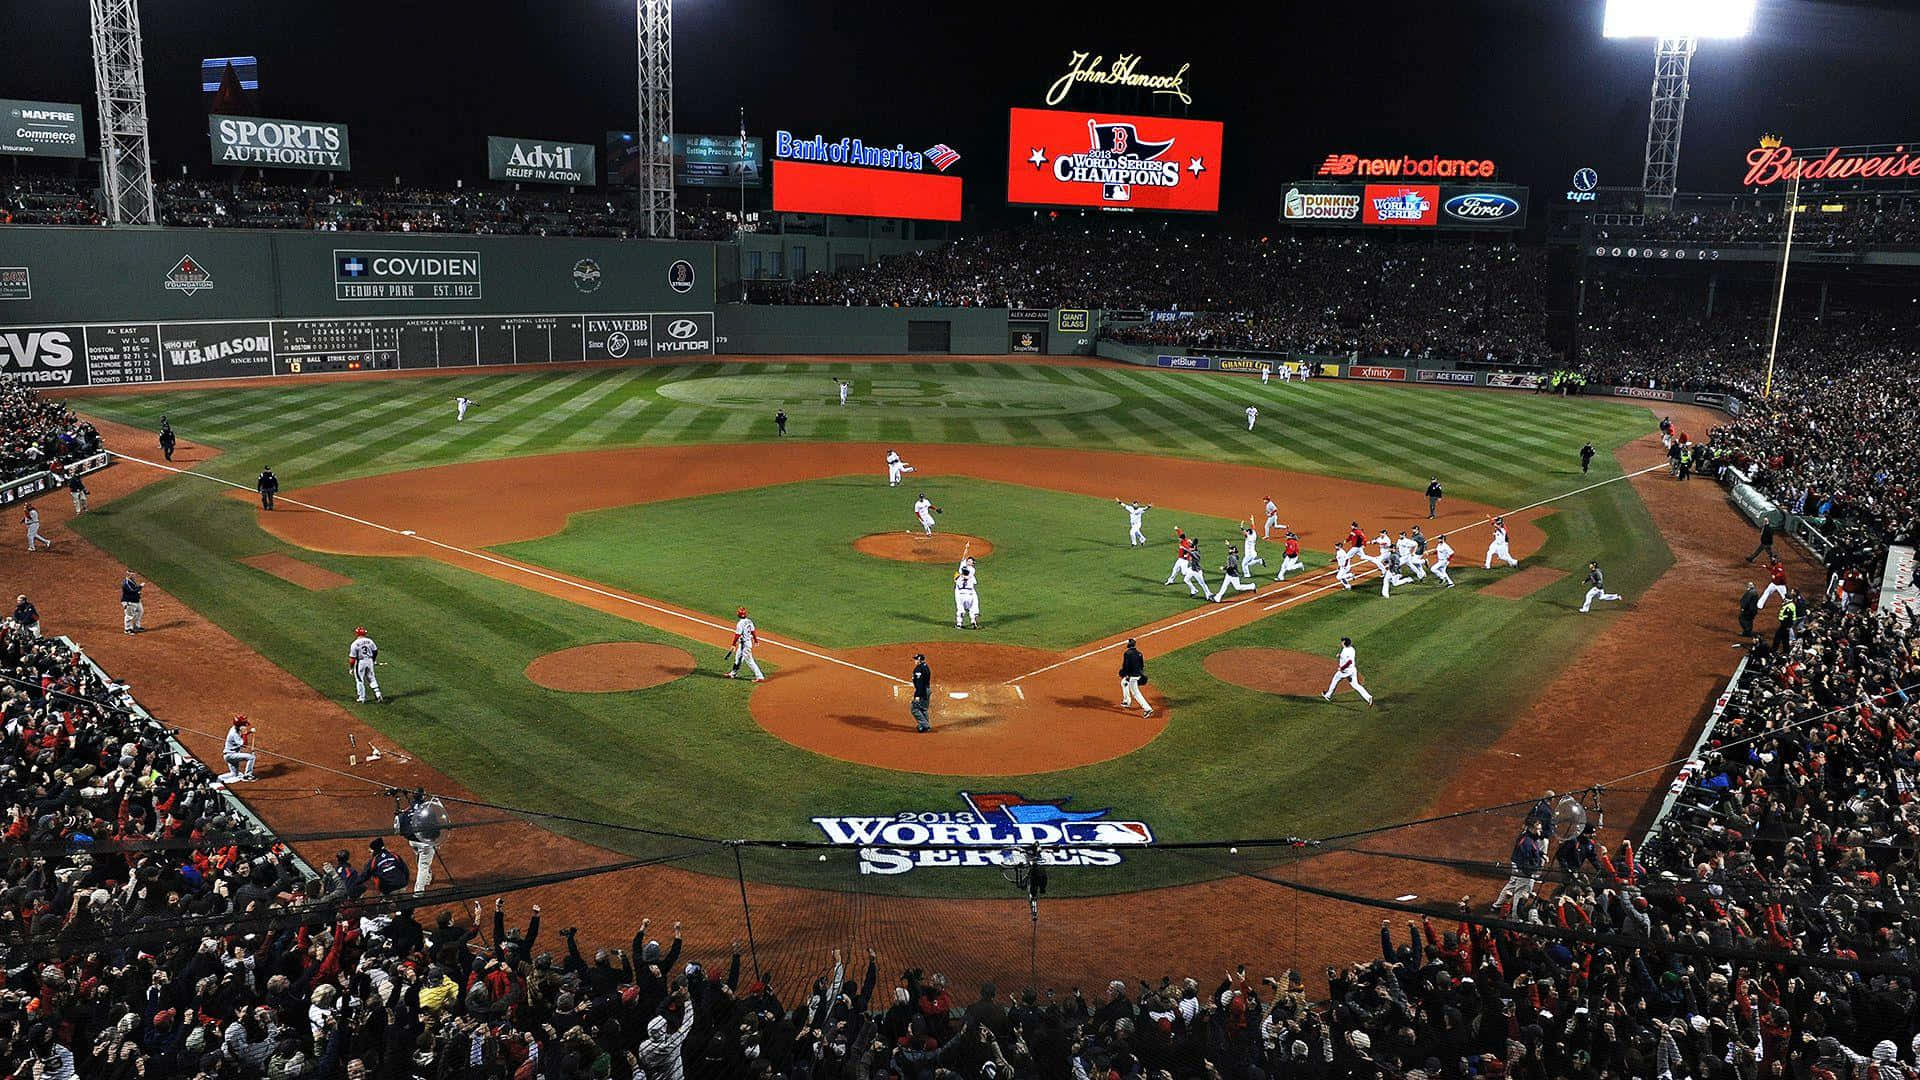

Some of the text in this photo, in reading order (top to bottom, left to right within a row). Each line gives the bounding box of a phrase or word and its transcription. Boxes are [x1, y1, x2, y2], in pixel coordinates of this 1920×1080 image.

[1046, 50, 1192, 106] John Hancock
[22, 109, 74, 122] MAPFRE
[16, 128, 76, 141] Commerce
[220, 119, 340, 151] SPORTS
[1111, 127, 1128, 154] B
[222, 145, 342, 166] AUTHORITY
[507, 143, 572, 170] Advil
[776, 130, 923, 171] Bank of America
[1089, 150, 1112, 159] 2013
[1073, 153, 1163, 173] WORLD SERIES
[1358, 158, 1402, 176] new
[1402, 154, 1496, 178] balance
[506, 167, 581, 182] RELIEF IN ACTION
[1053, 155, 1180, 187] CHAMPIONS
[1373, 199, 1415, 211] WORLD
[1457, 198, 1506, 218] Ford
[1305, 206, 1355, 218] DONUTS
[1378, 209, 1422, 220] SERIES
[373, 257, 477, 276] COVIDIEN
[344, 285, 474, 297] FENWAY PARK EST. 1912
[613, 320, 648, 331] WEBB
[1061, 320, 1085, 328] GLASS
[588, 340, 604, 348] Since
[656, 340, 709, 352] HYUNDAI
[1171, 357, 1197, 367] jetBlue
[1221, 360, 1253, 369] GRANITE
[1361, 367, 1392, 379] xfinity
[1451, 373, 1474, 381] TICKET
[92, 376, 121, 384] TORONTO
[898, 811, 975, 824] 2013
[812, 817, 1062, 845] WORLD
